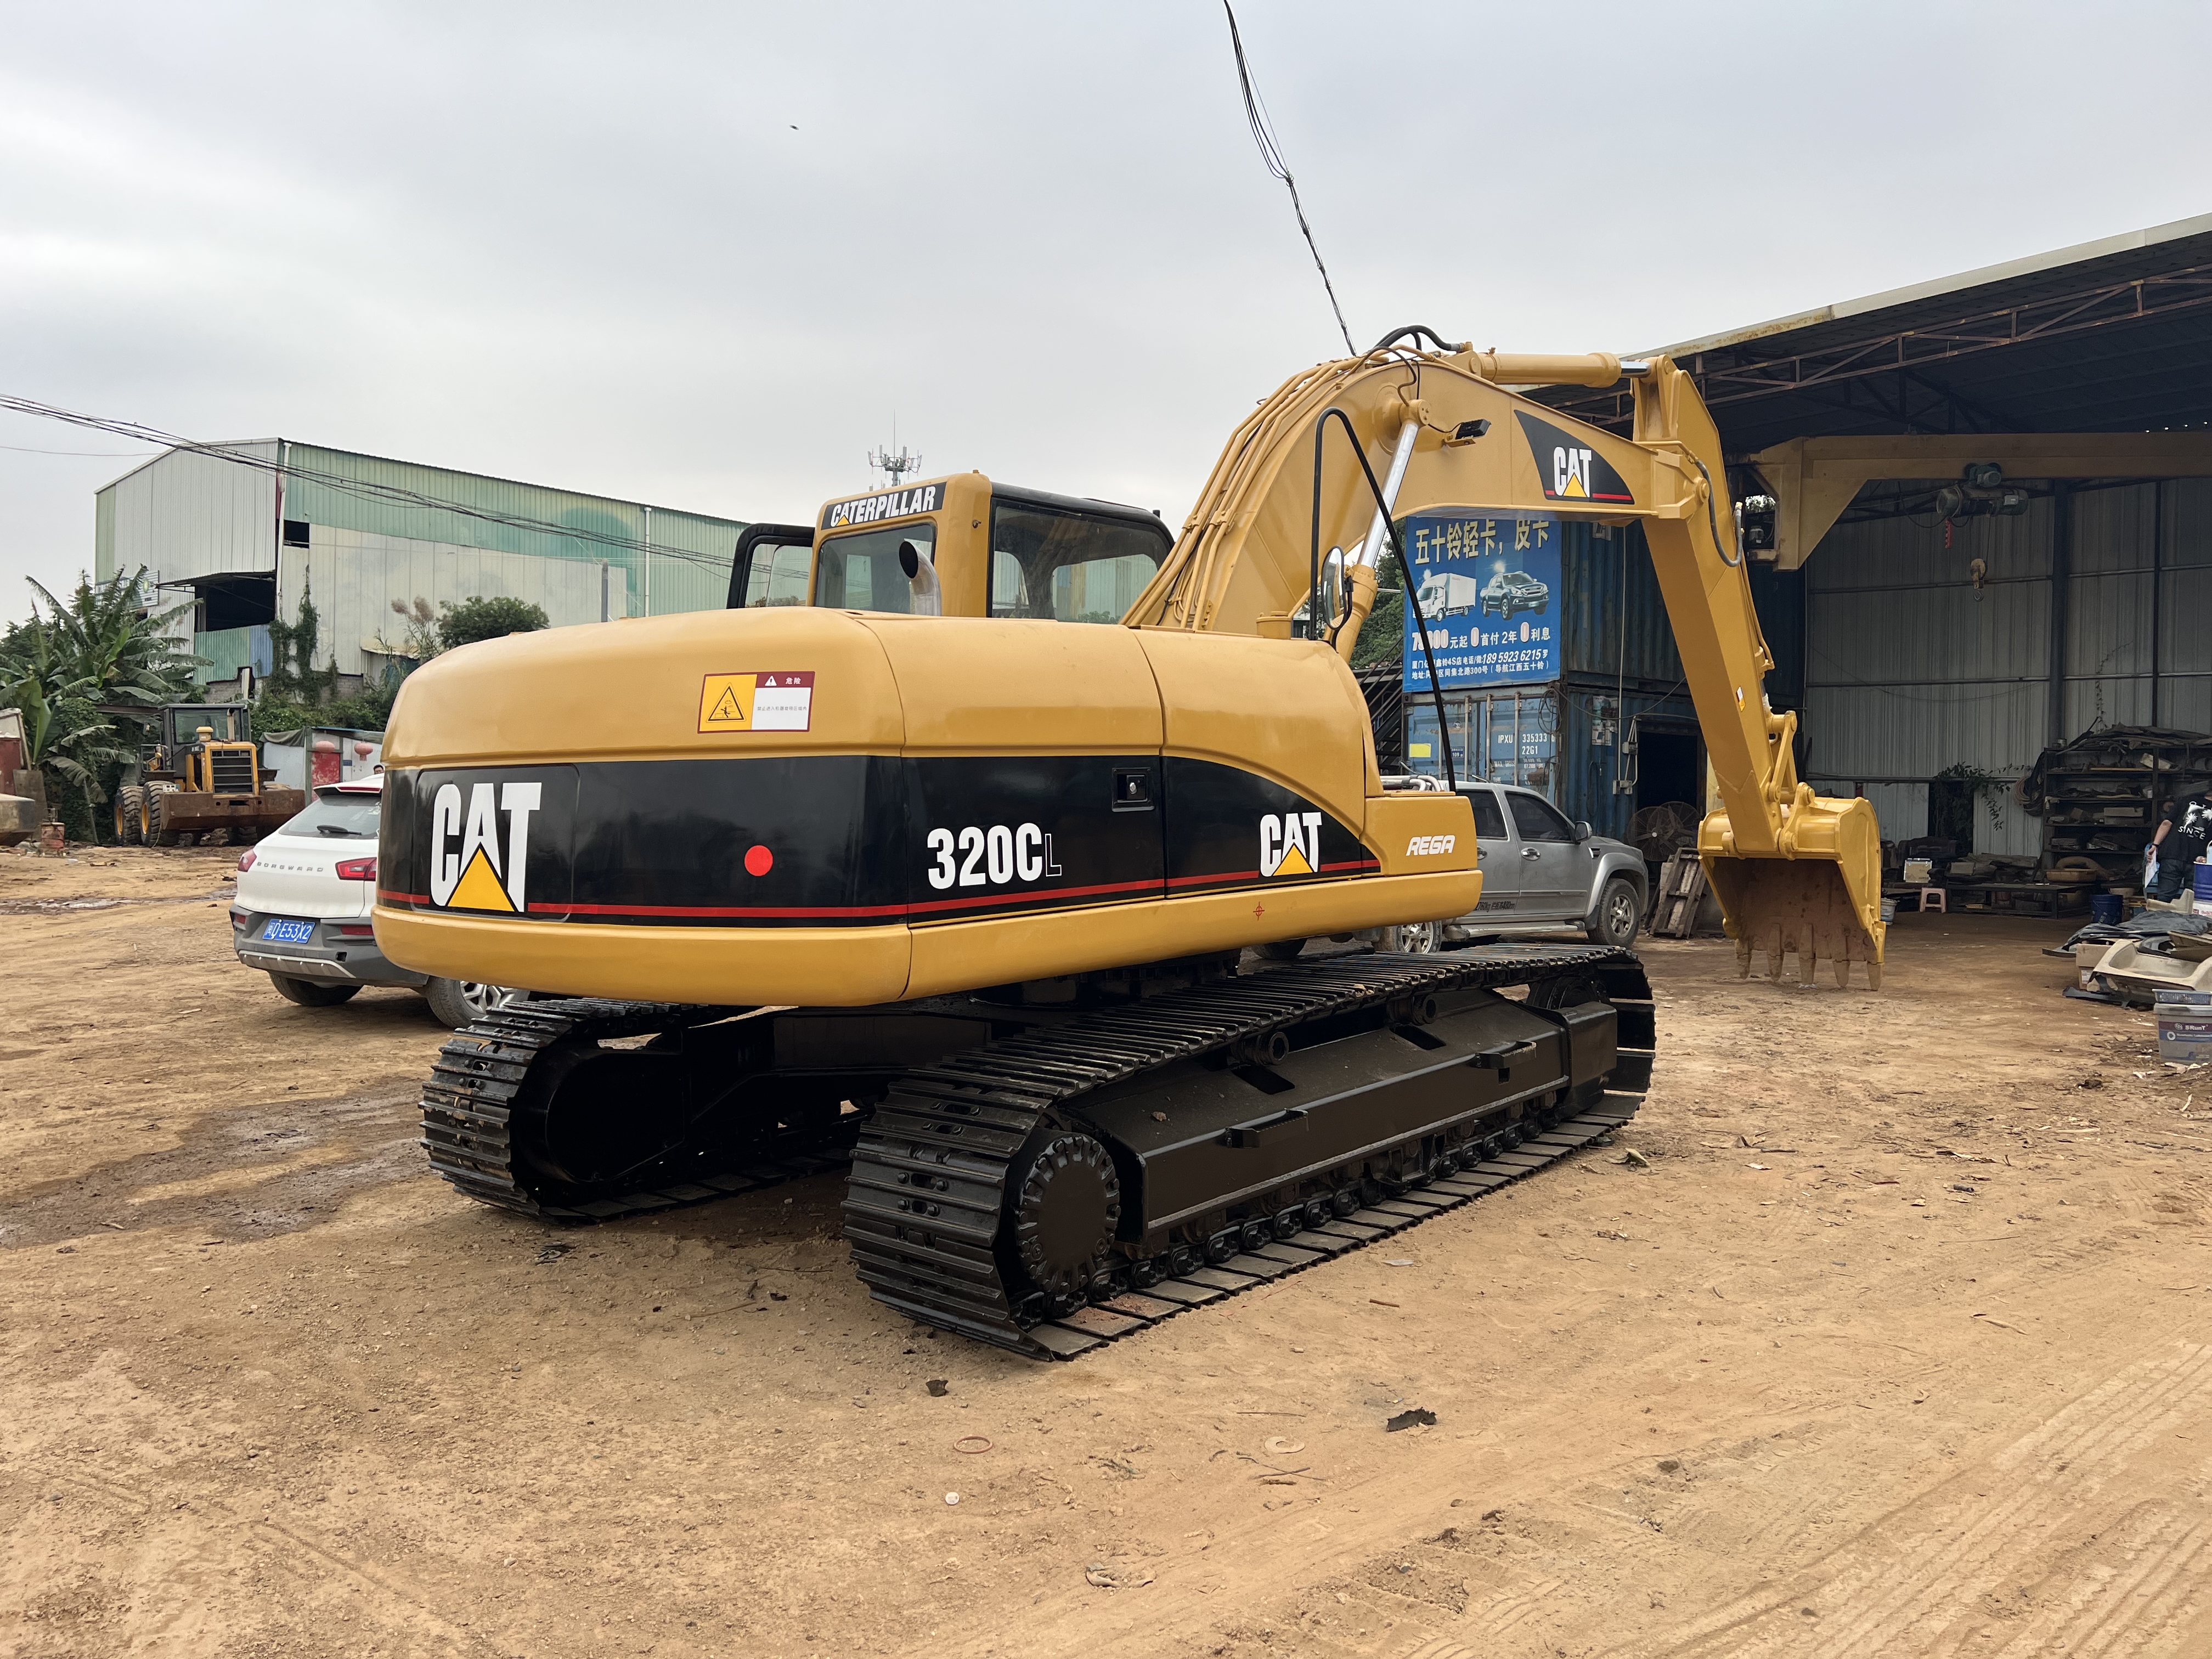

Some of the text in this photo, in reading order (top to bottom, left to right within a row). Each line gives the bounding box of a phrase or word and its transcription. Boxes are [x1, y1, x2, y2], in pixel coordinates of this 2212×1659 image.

[1554, 446, 1592, 498] CAT
[830, 486, 936, 527] CATERPILLAR
[1498, 735, 1513, 743] IPXU
[1522, 733, 1547, 743] 335333
[1522, 746, 1538, 755] 22G1
[2177, 826, 2206, 840] SINCE
[430, 782, 542, 912] CAT
[1260, 812, 1322, 877] CAT
[1406, 834, 1455, 856] REGA
[257, 861, 324, 872] BORGWARD
